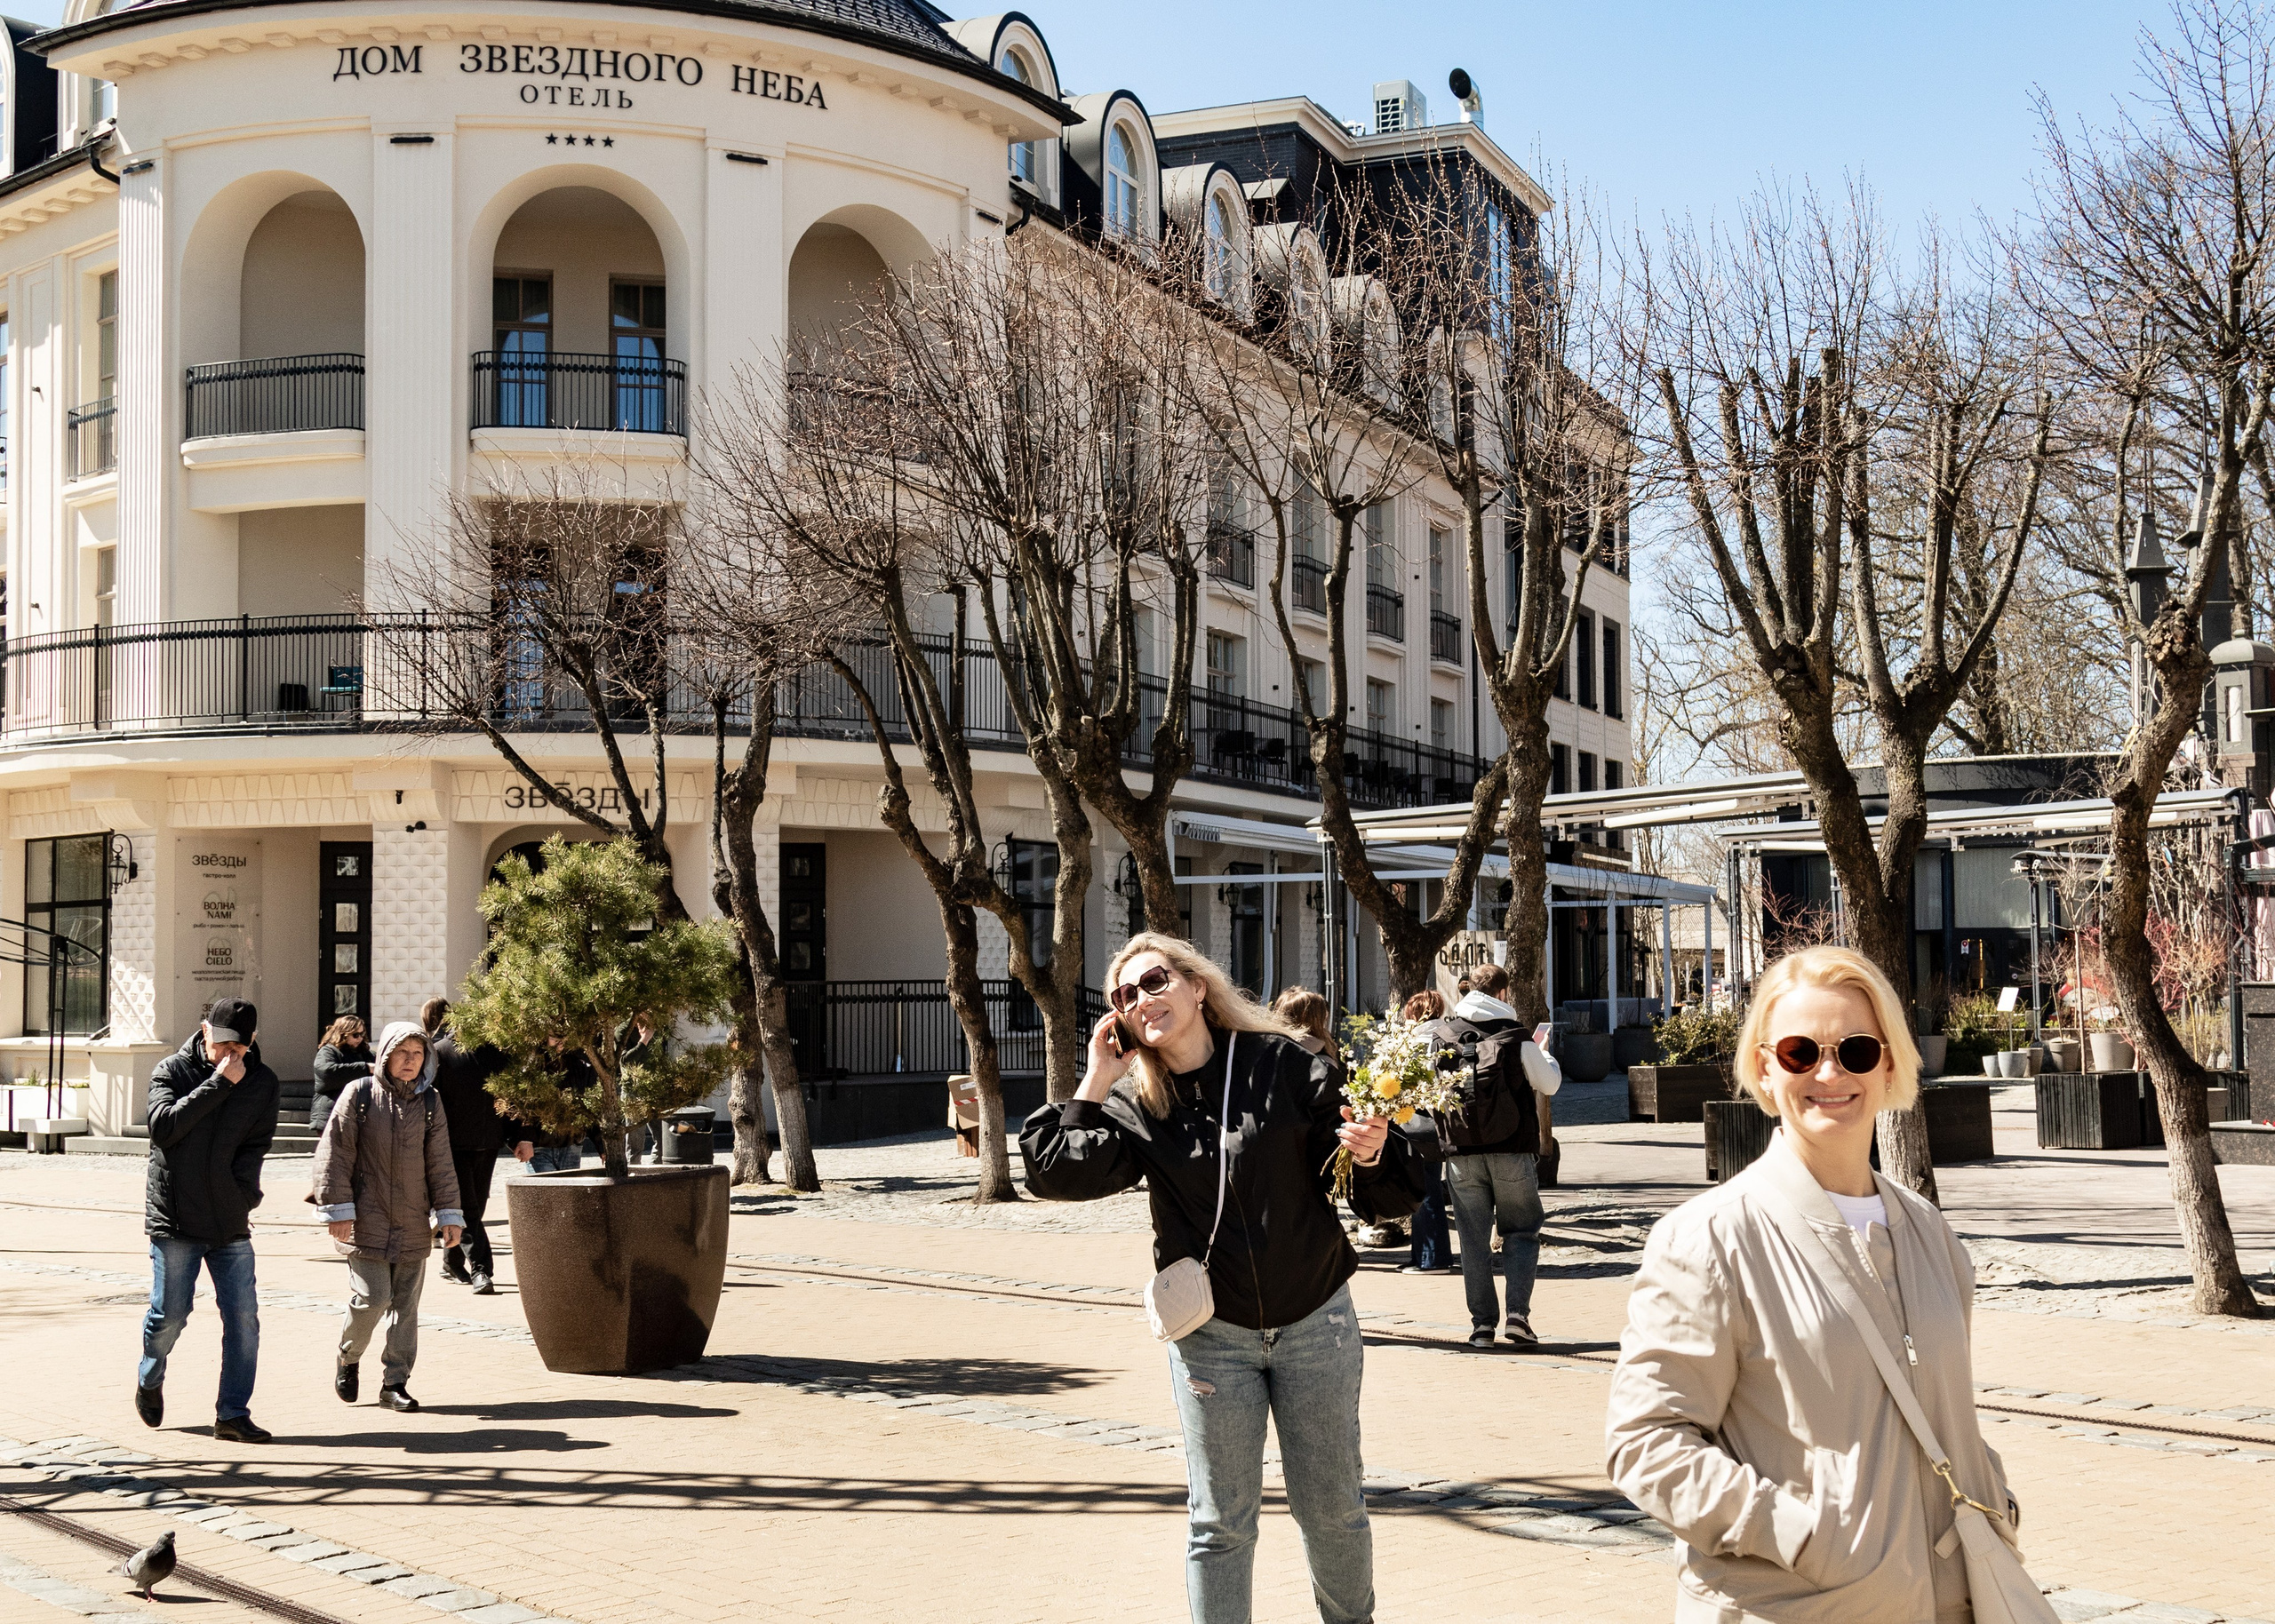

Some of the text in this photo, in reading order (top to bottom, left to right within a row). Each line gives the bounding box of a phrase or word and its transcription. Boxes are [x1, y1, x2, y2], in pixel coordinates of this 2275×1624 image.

[333, 44, 828, 110] ДОМ ЗВЕЗДНОГО НЕБА
[520, 84, 634, 108] ОТЕЛЬ
[204, 901, 235, 911] ВОЛНА
[207, 911, 232, 919] NAMI
[207, 947, 232, 957] НЕБО
[205, 956, 233, 966] CIELO
